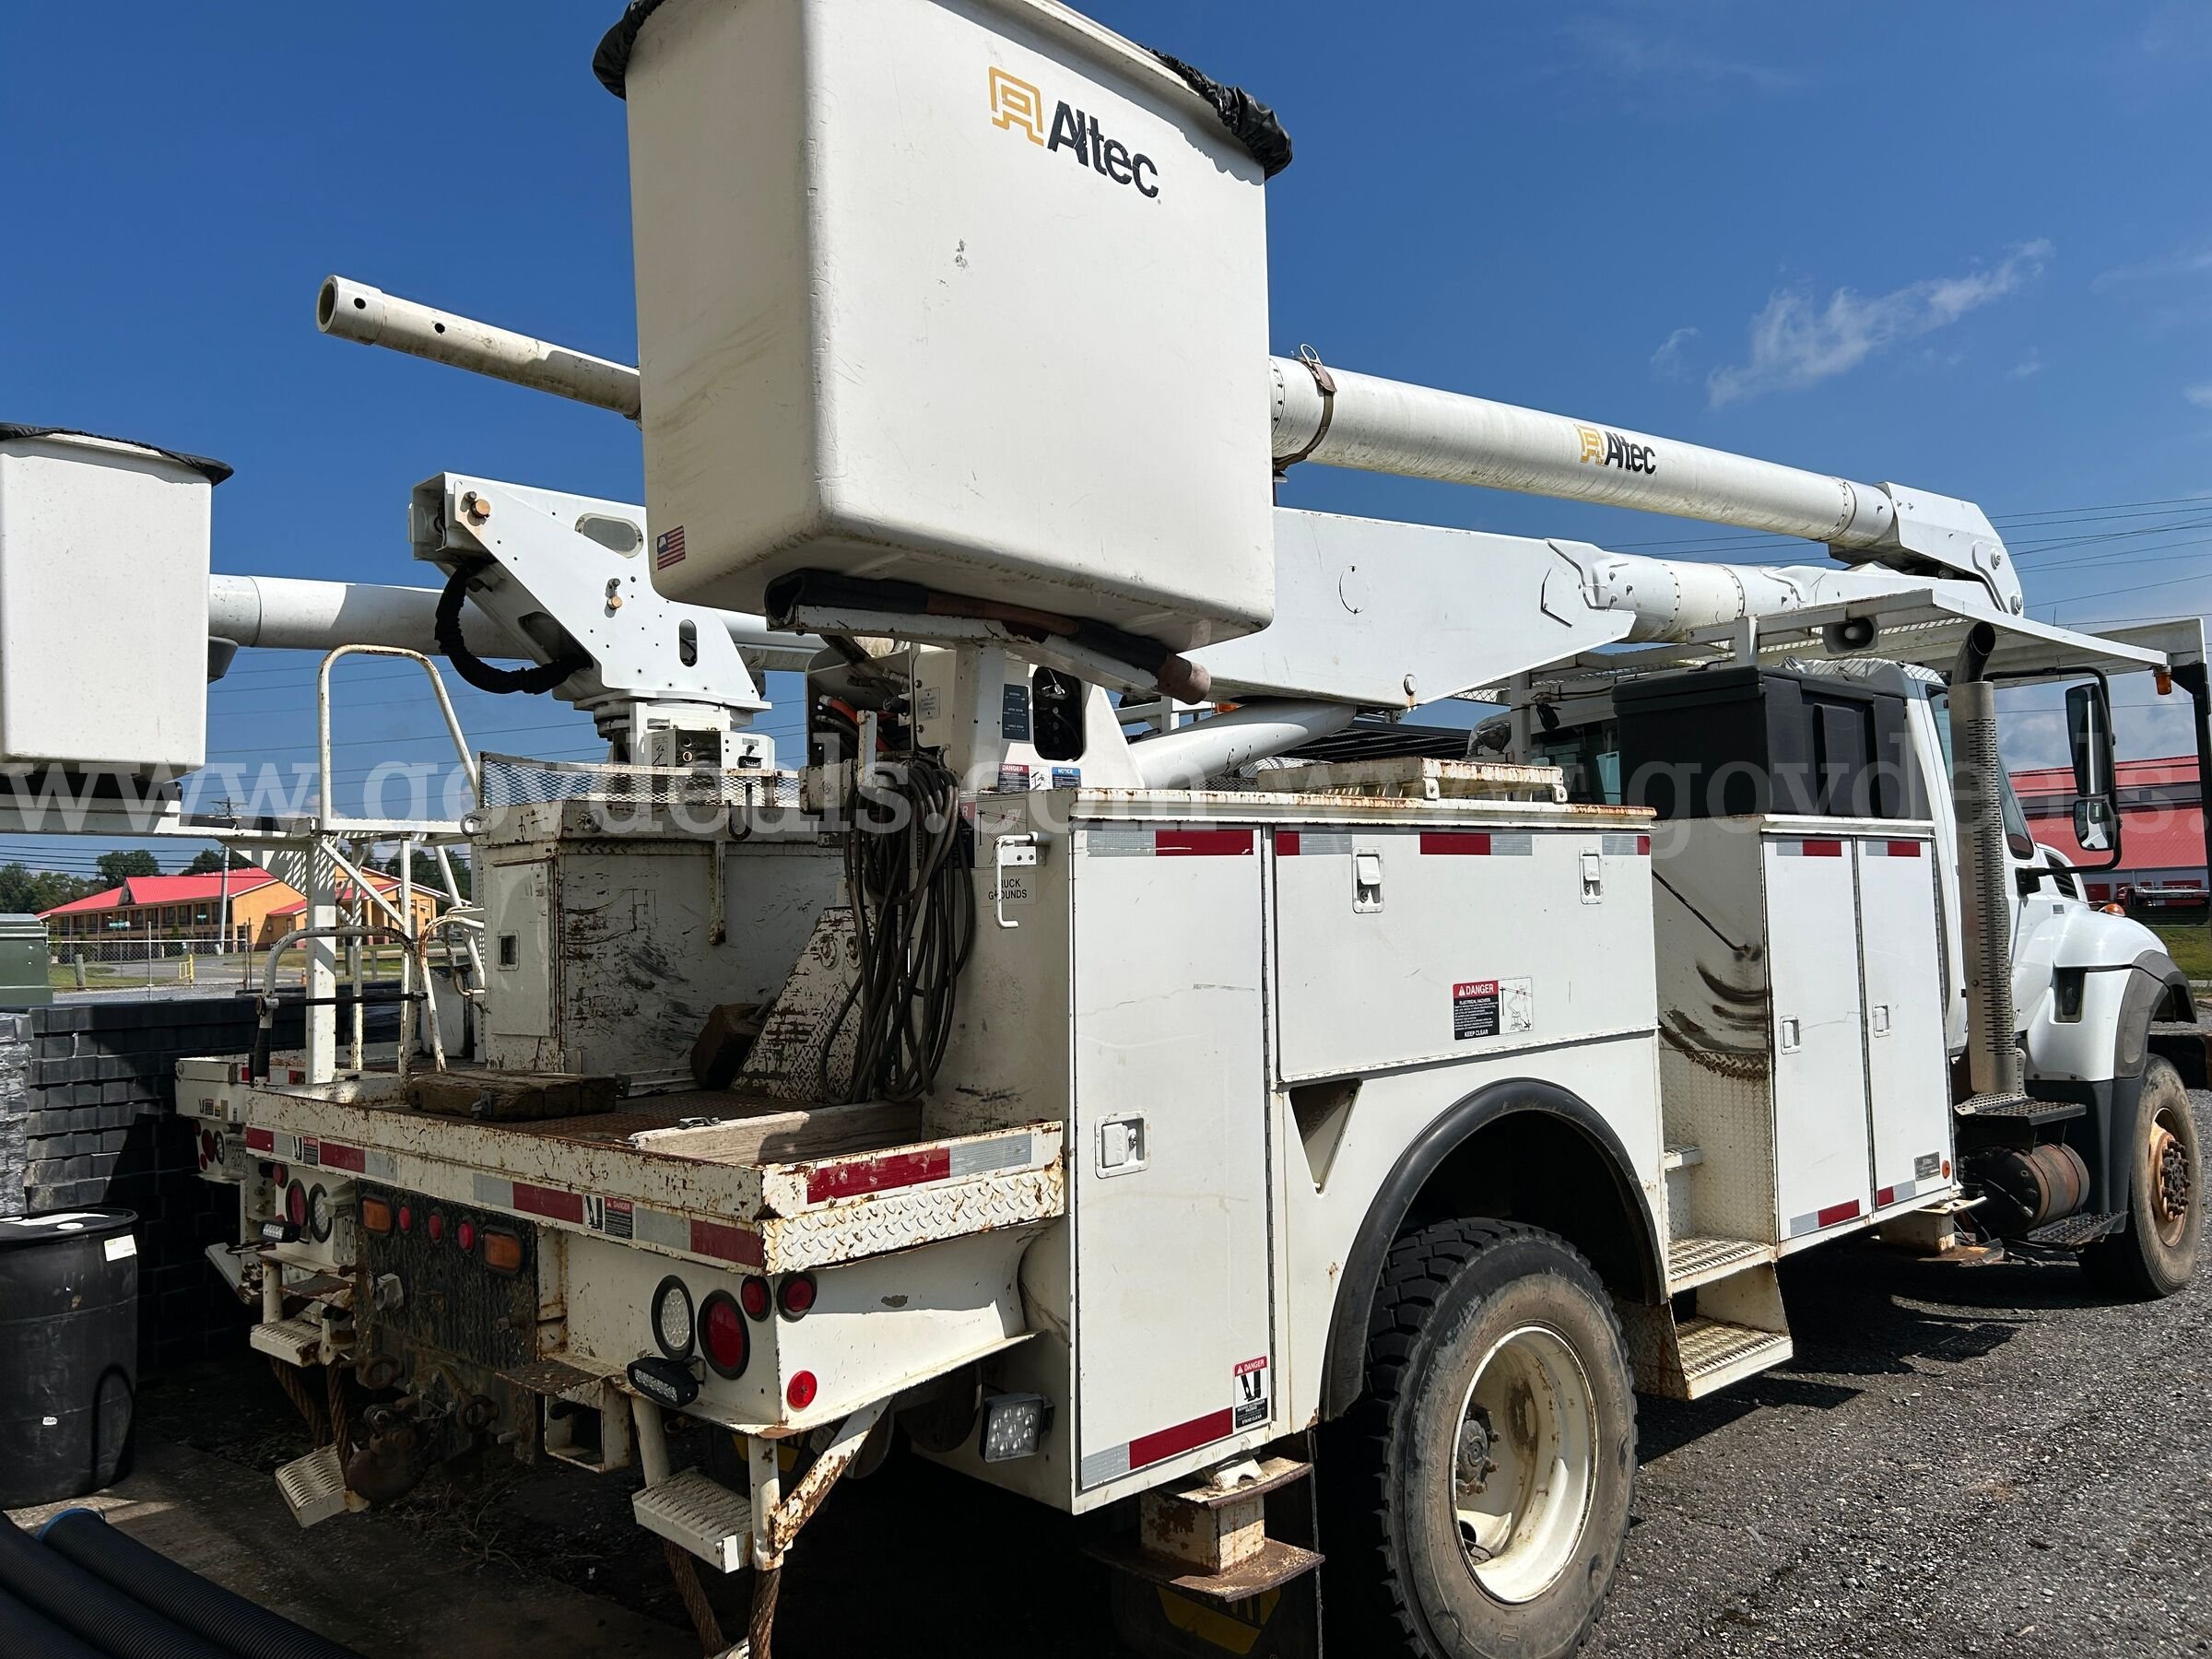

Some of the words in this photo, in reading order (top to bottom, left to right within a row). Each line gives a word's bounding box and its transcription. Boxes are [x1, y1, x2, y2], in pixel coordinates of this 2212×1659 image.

[1046, 100, 1159, 198] Altec
[1604, 430, 1656, 475] Altec
[1001, 764, 1024, 772] DANGER
[994, 878, 1021, 889] RUCK
[1465, 982, 1494, 995] DANGER
[1243, 1359, 1265, 1372] DANGER
